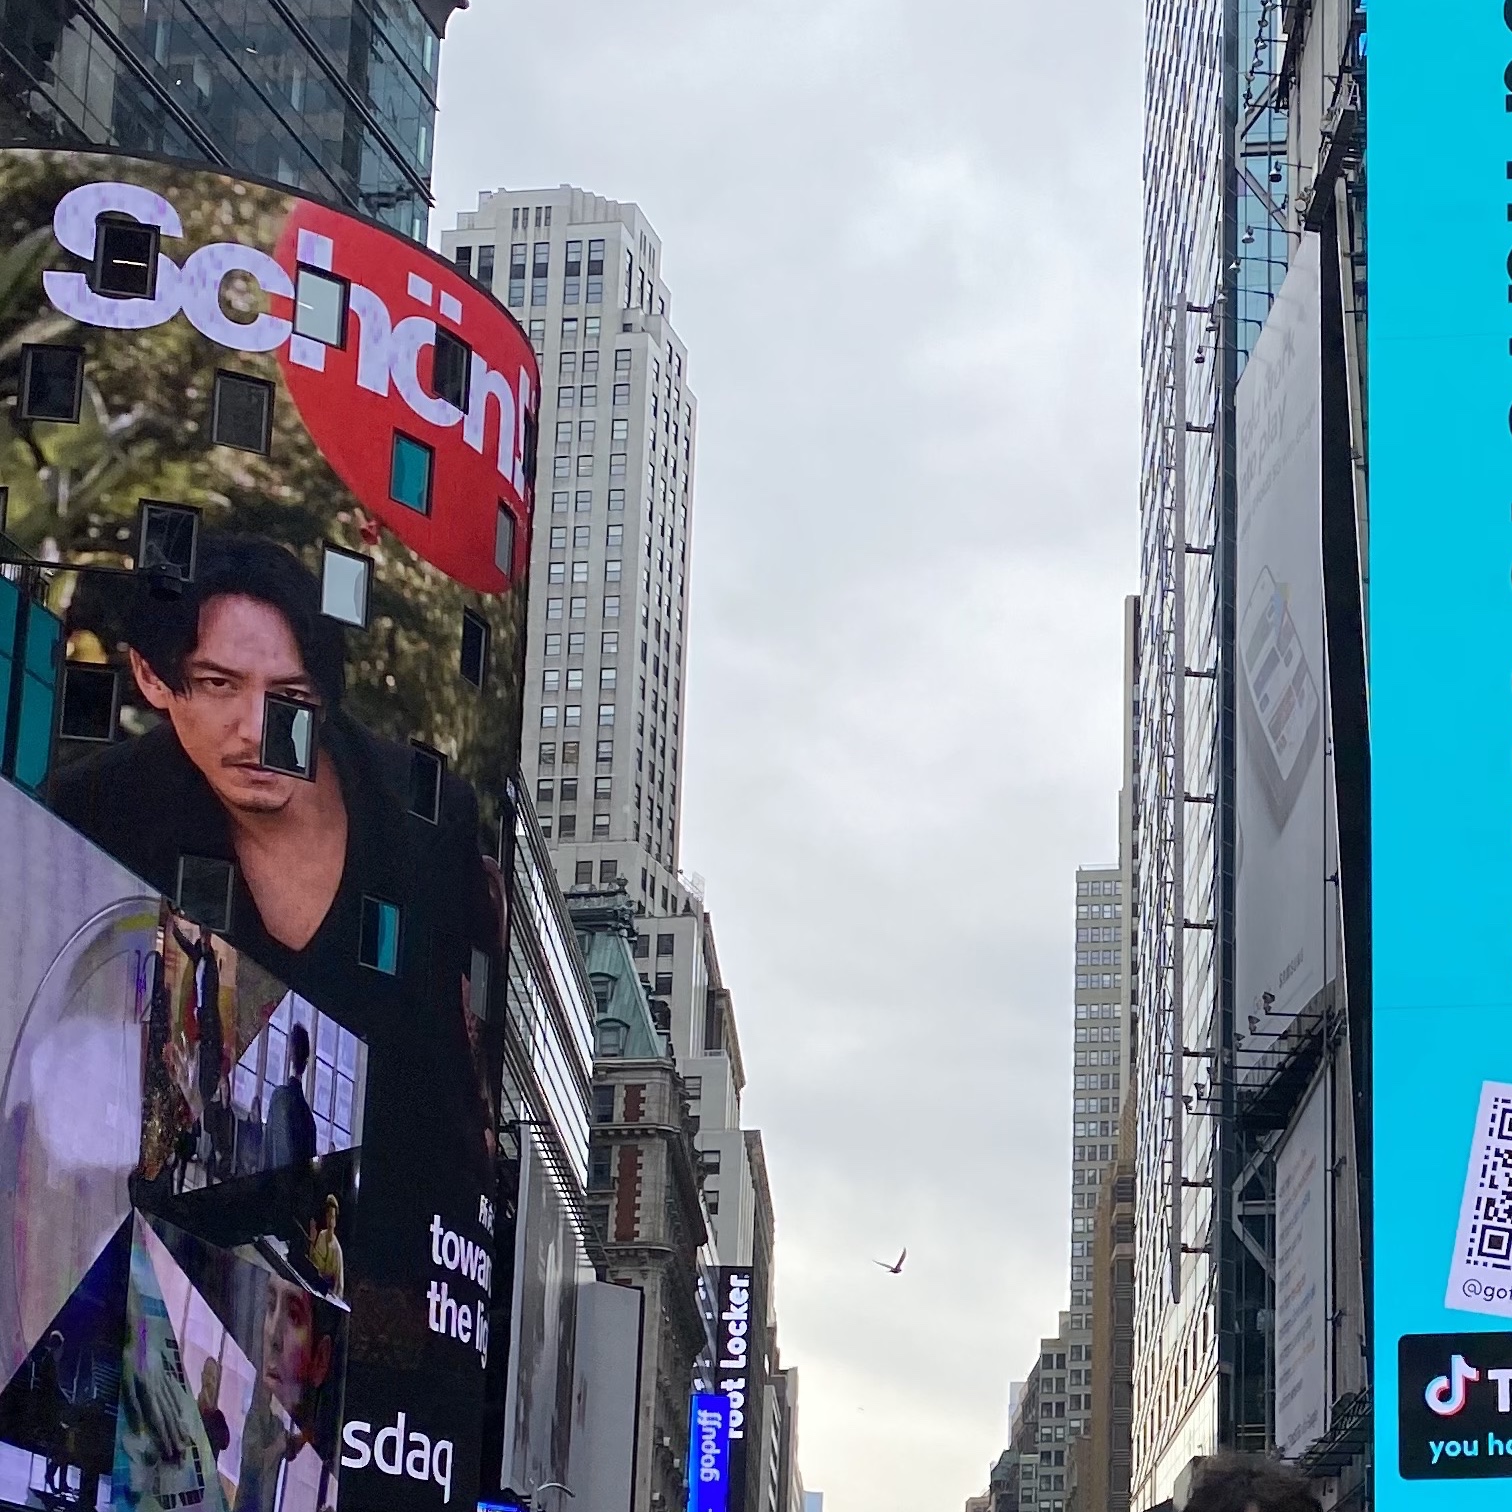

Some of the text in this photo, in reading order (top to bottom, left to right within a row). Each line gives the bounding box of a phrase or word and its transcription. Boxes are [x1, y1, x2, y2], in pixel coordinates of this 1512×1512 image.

[426, 1280, 472, 1344] the
[719, 1274, 750, 1369] Locker
[341, 1412, 454, 1504] sdaq
[697, 1409, 722, 1482] gopuff
[1429, 1433, 1479, 1464] you
